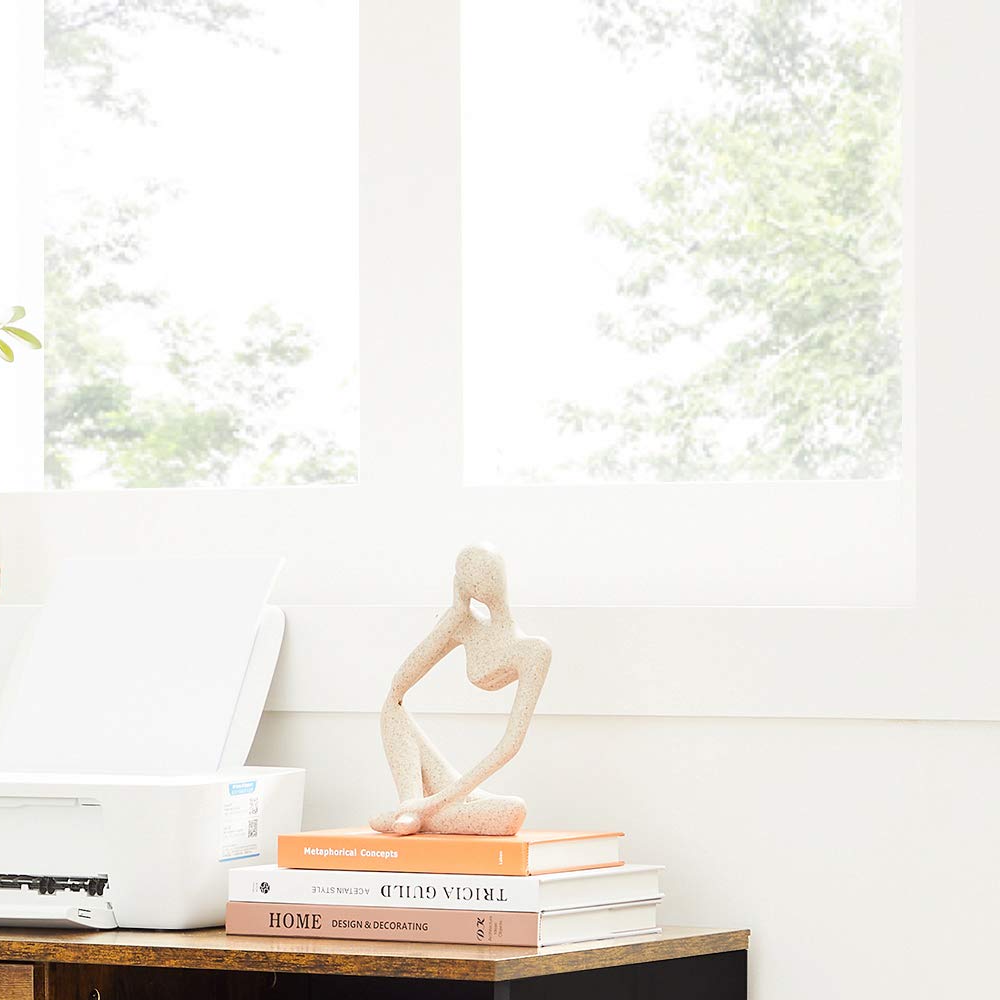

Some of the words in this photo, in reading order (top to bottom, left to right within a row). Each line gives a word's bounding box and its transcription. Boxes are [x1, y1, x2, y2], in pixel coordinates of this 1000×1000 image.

[304, 847, 357, 856] Metaphorical
[360, 848, 398, 858] Concepts
[380, 885, 437, 899] GUILD
[442, 886, 508, 902] TRICIA
[269, 912, 322, 930] HOME
[332, 920, 362, 929] DESIGN
[364, 921, 372, 929] &
[374, 921, 428, 931] DECORATING
